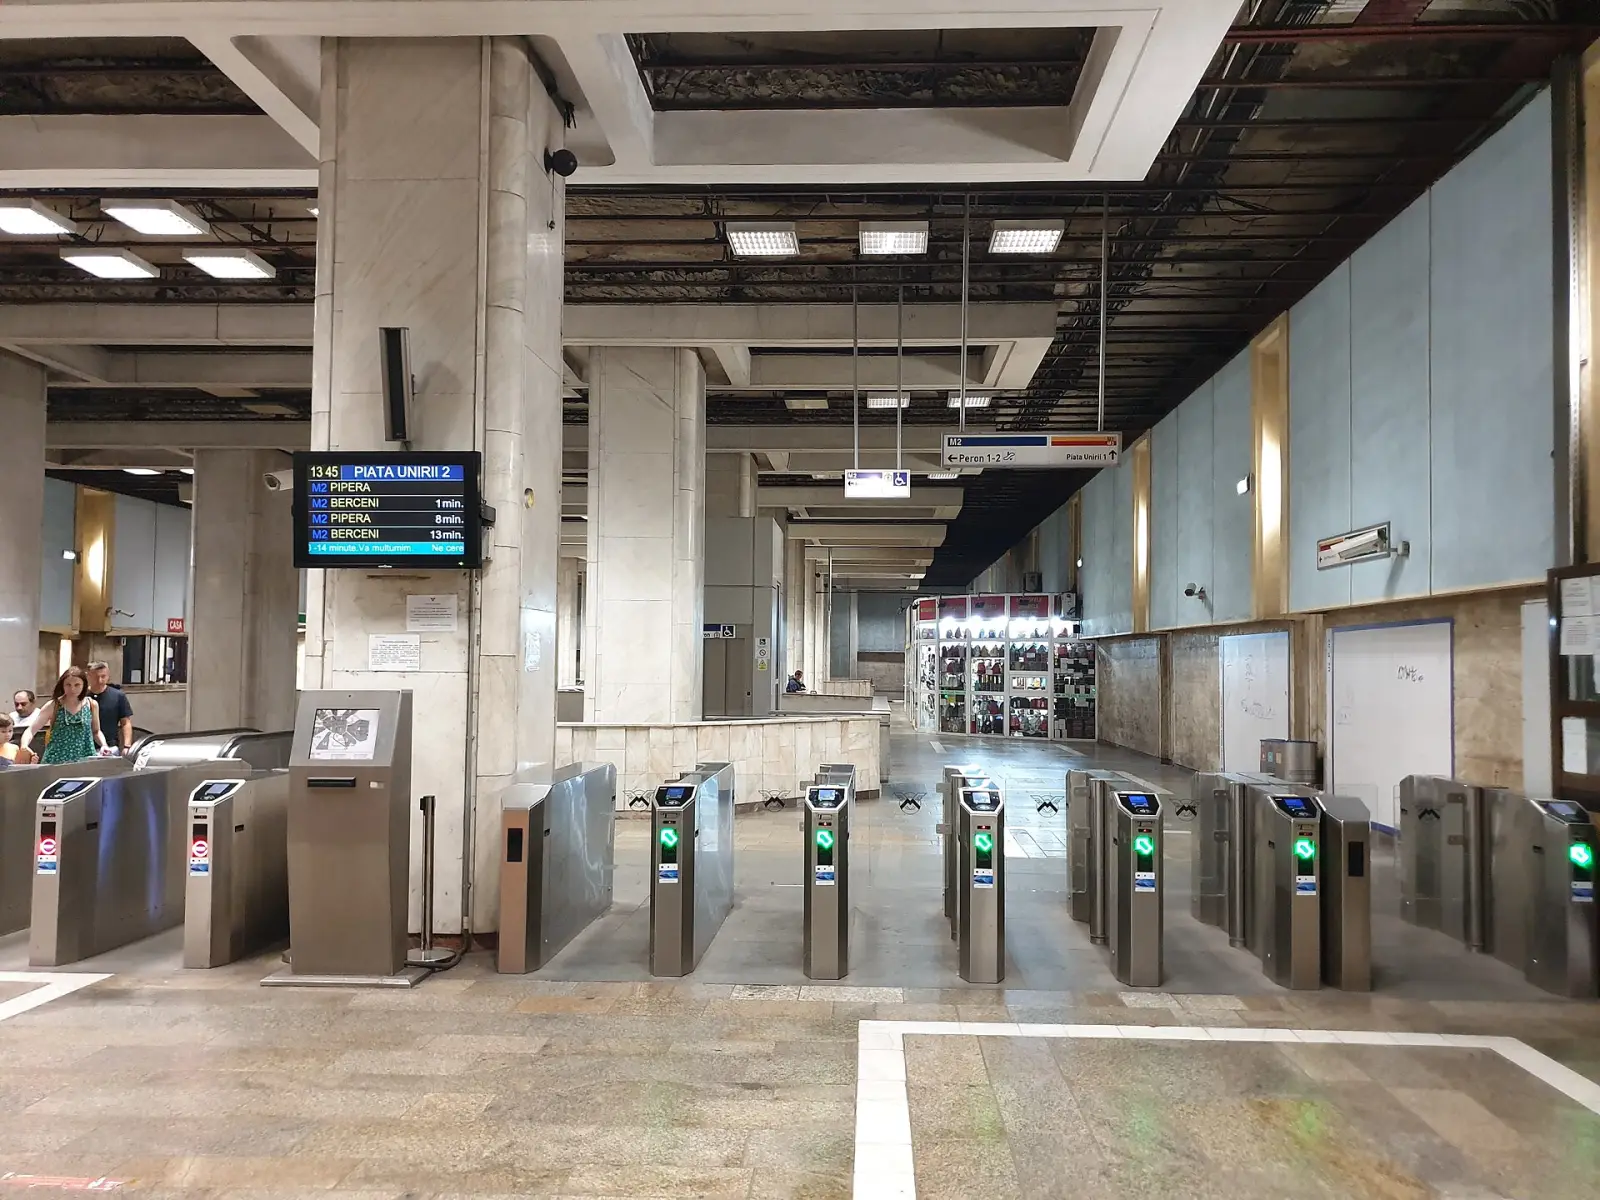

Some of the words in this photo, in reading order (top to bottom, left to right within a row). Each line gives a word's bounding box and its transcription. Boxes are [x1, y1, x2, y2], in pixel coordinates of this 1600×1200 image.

[960, 454, 984, 462] Peron
[987, 454, 1001, 462] 1-2
[354, 466, 394, 478] PIATA
[397, 466, 438, 478] UNIRII
[442, 466, 450, 478] 2
[312, 483, 327, 492] M2
[330, 482, 371, 492] PIPERA
[312, 499, 327, 508] M2
[330, 498, 379, 508] BERCENI
[312, 514, 327, 524] M2
[330, 514, 371, 523] PIPERA
[312, 530, 327, 539] M2
[330, 529, 379, 539] BERCENI
[170, 620, 182, 629] CASA
